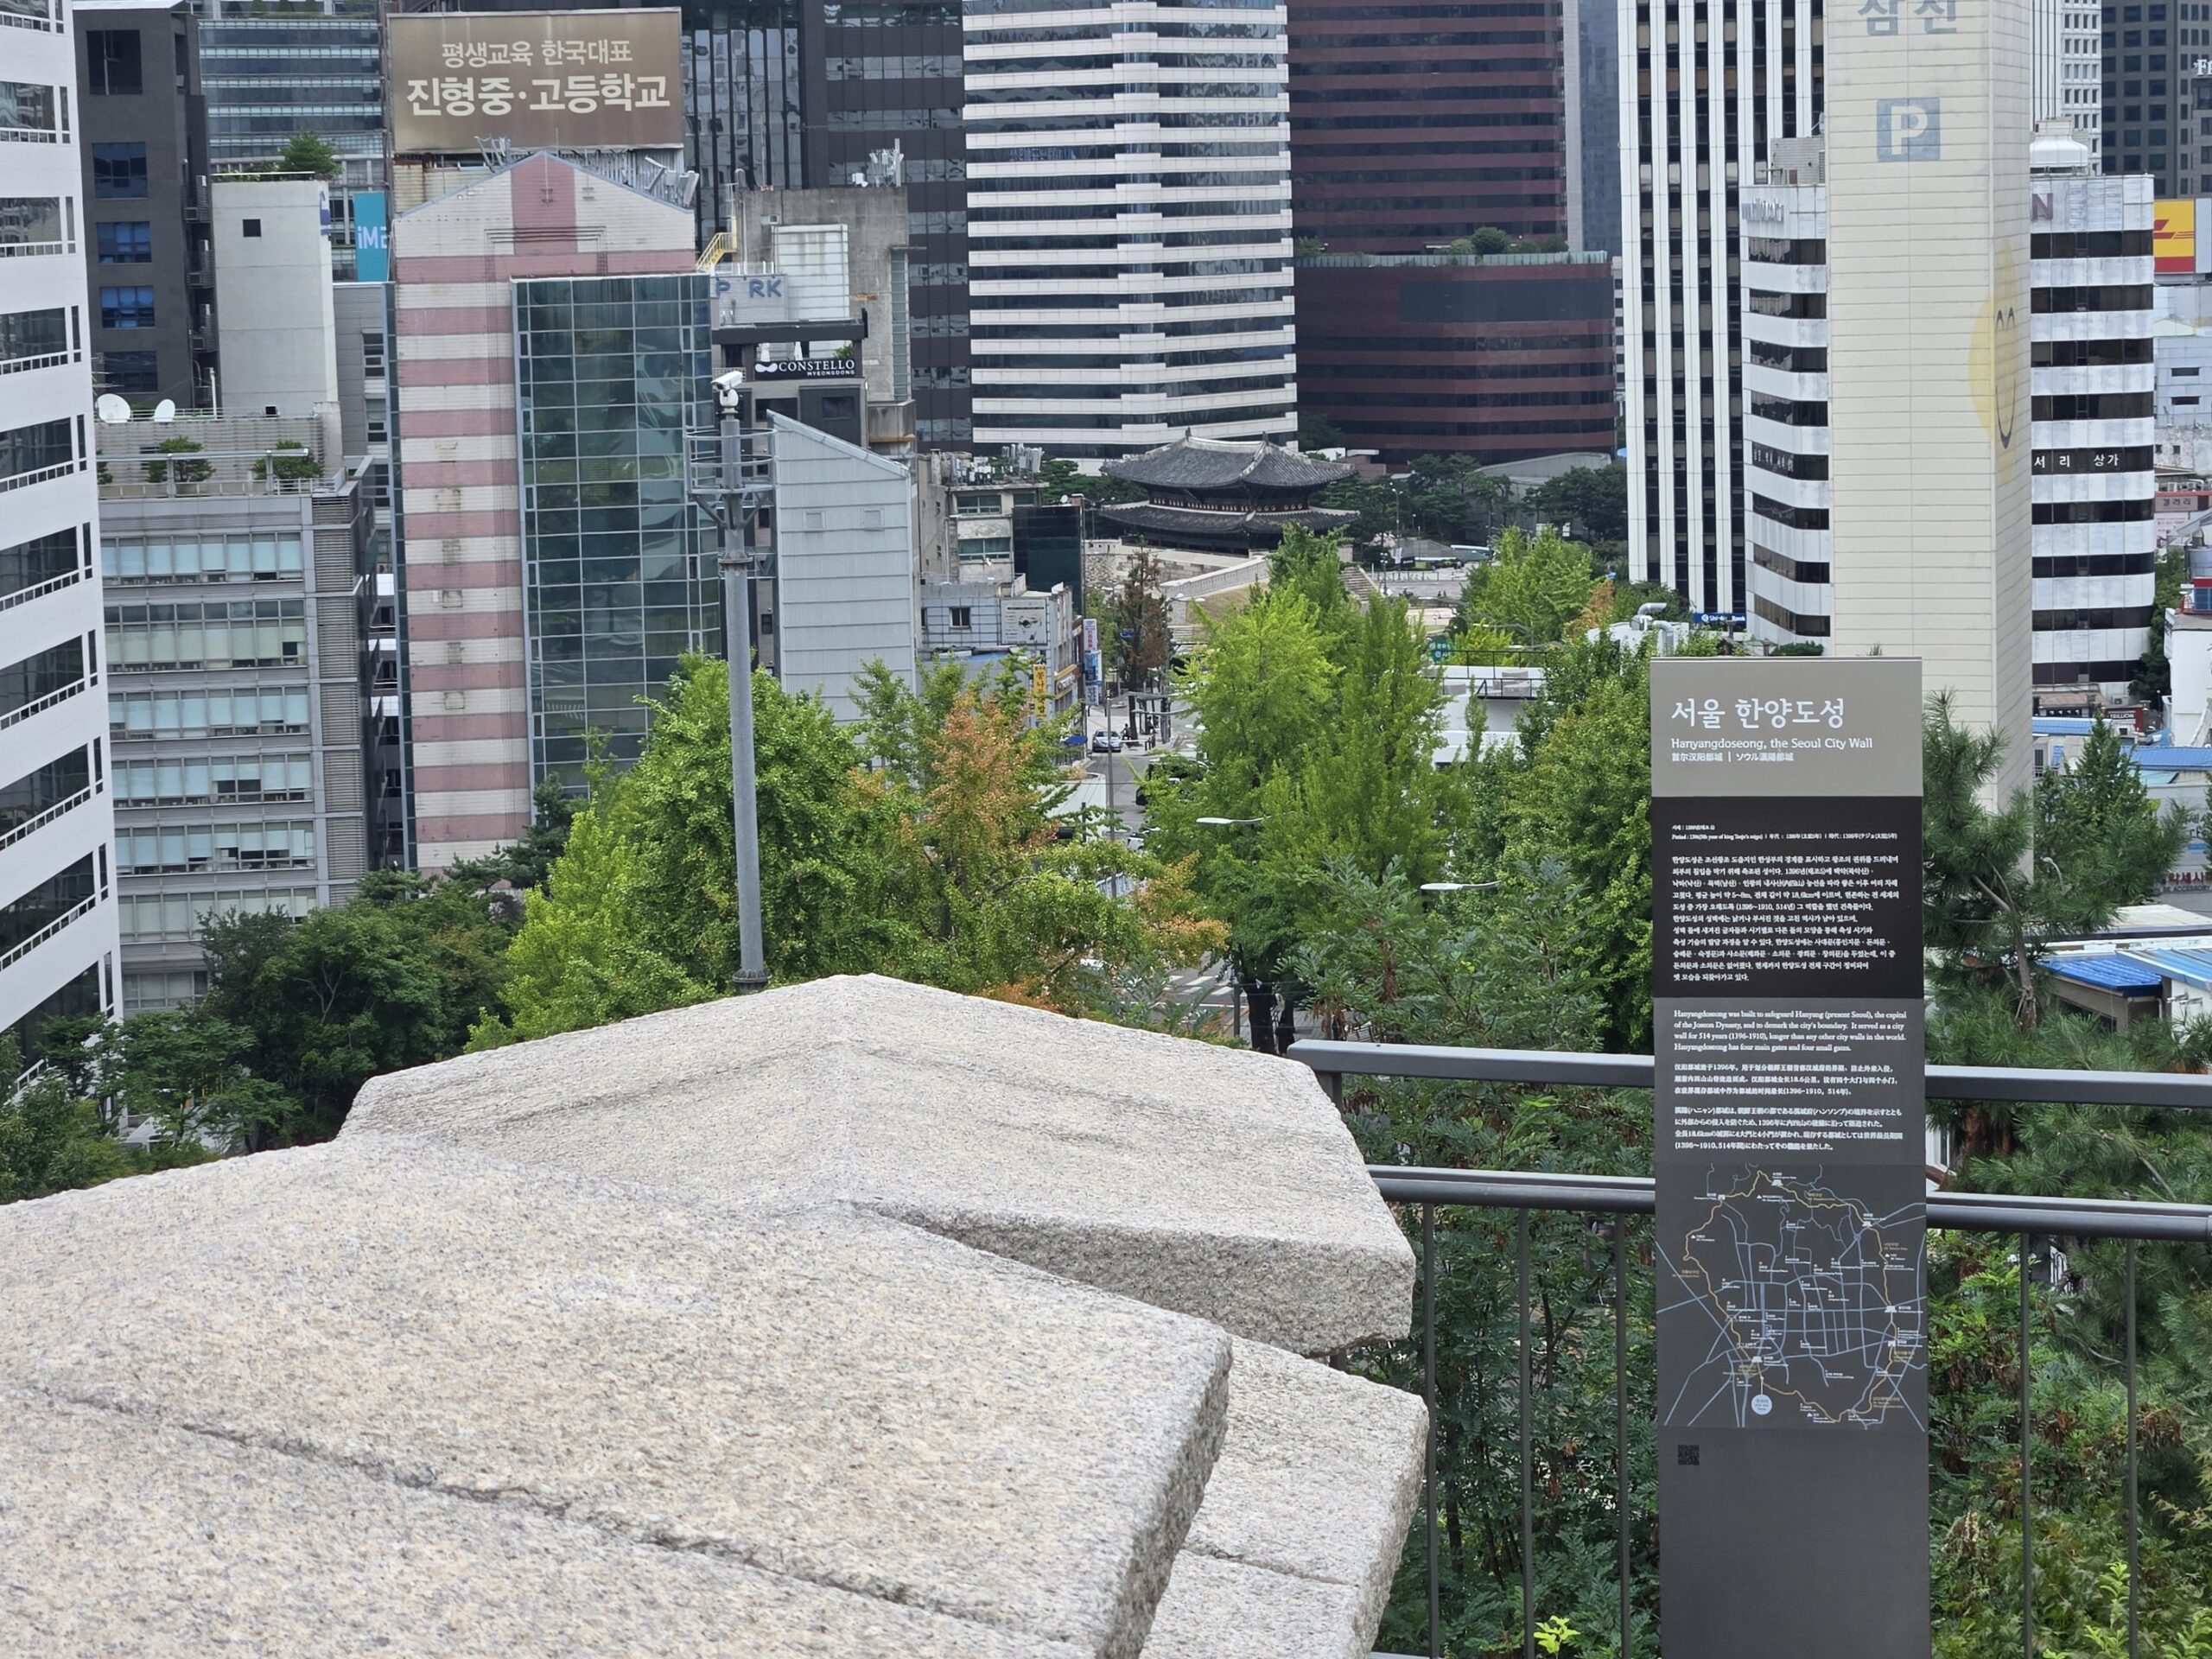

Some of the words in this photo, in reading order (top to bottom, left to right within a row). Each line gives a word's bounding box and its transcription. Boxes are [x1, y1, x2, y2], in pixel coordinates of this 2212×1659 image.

[442, 41, 533, 69] 평생교육
[541, 40, 632, 66] 한국대표
[406, 73, 671, 117] 진형중·고등학교
[1891, 105, 1928, 156] P
[779, 359, 855, 372] CONSTELLO
[2094, 454, 2120, 467] 상가
[1672, 698, 1726, 728] 서울
[1735, 698, 1845, 728] 한양도성
[1671, 738, 1767, 750] Hanyangdoseong,
[1770, 738, 1789, 748] the
[1791, 738, 1821, 748] Seoul
[1825, 738, 1847, 750] City
[1849, 738, 1873, 748] Wall
